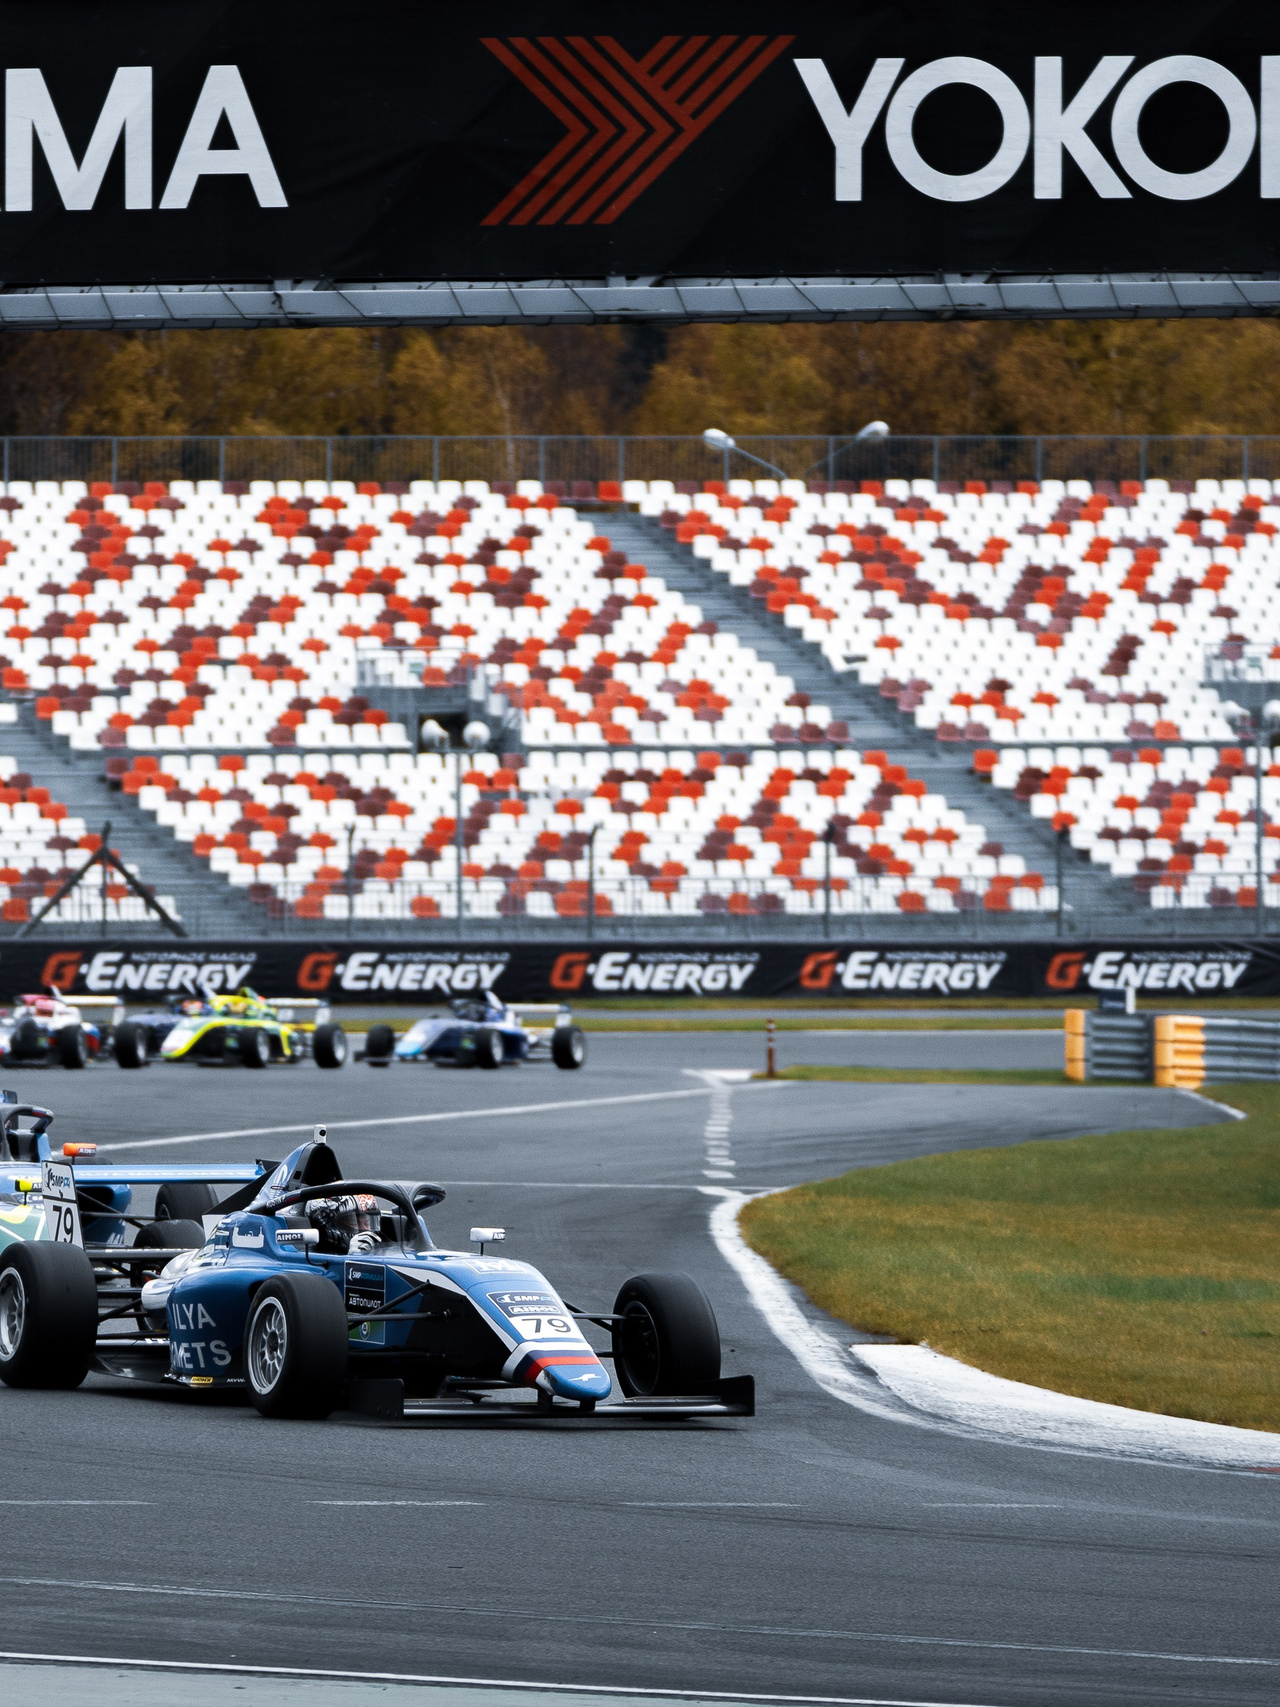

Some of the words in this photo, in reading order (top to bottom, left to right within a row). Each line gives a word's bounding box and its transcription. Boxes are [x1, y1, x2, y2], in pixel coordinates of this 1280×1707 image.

[793, 54, 1280, 202] YOKO
[52, 1204, 74, 1244] 79
[172, 1303, 217, 1330] ILYA
[521, 1318, 572, 1334] 79
